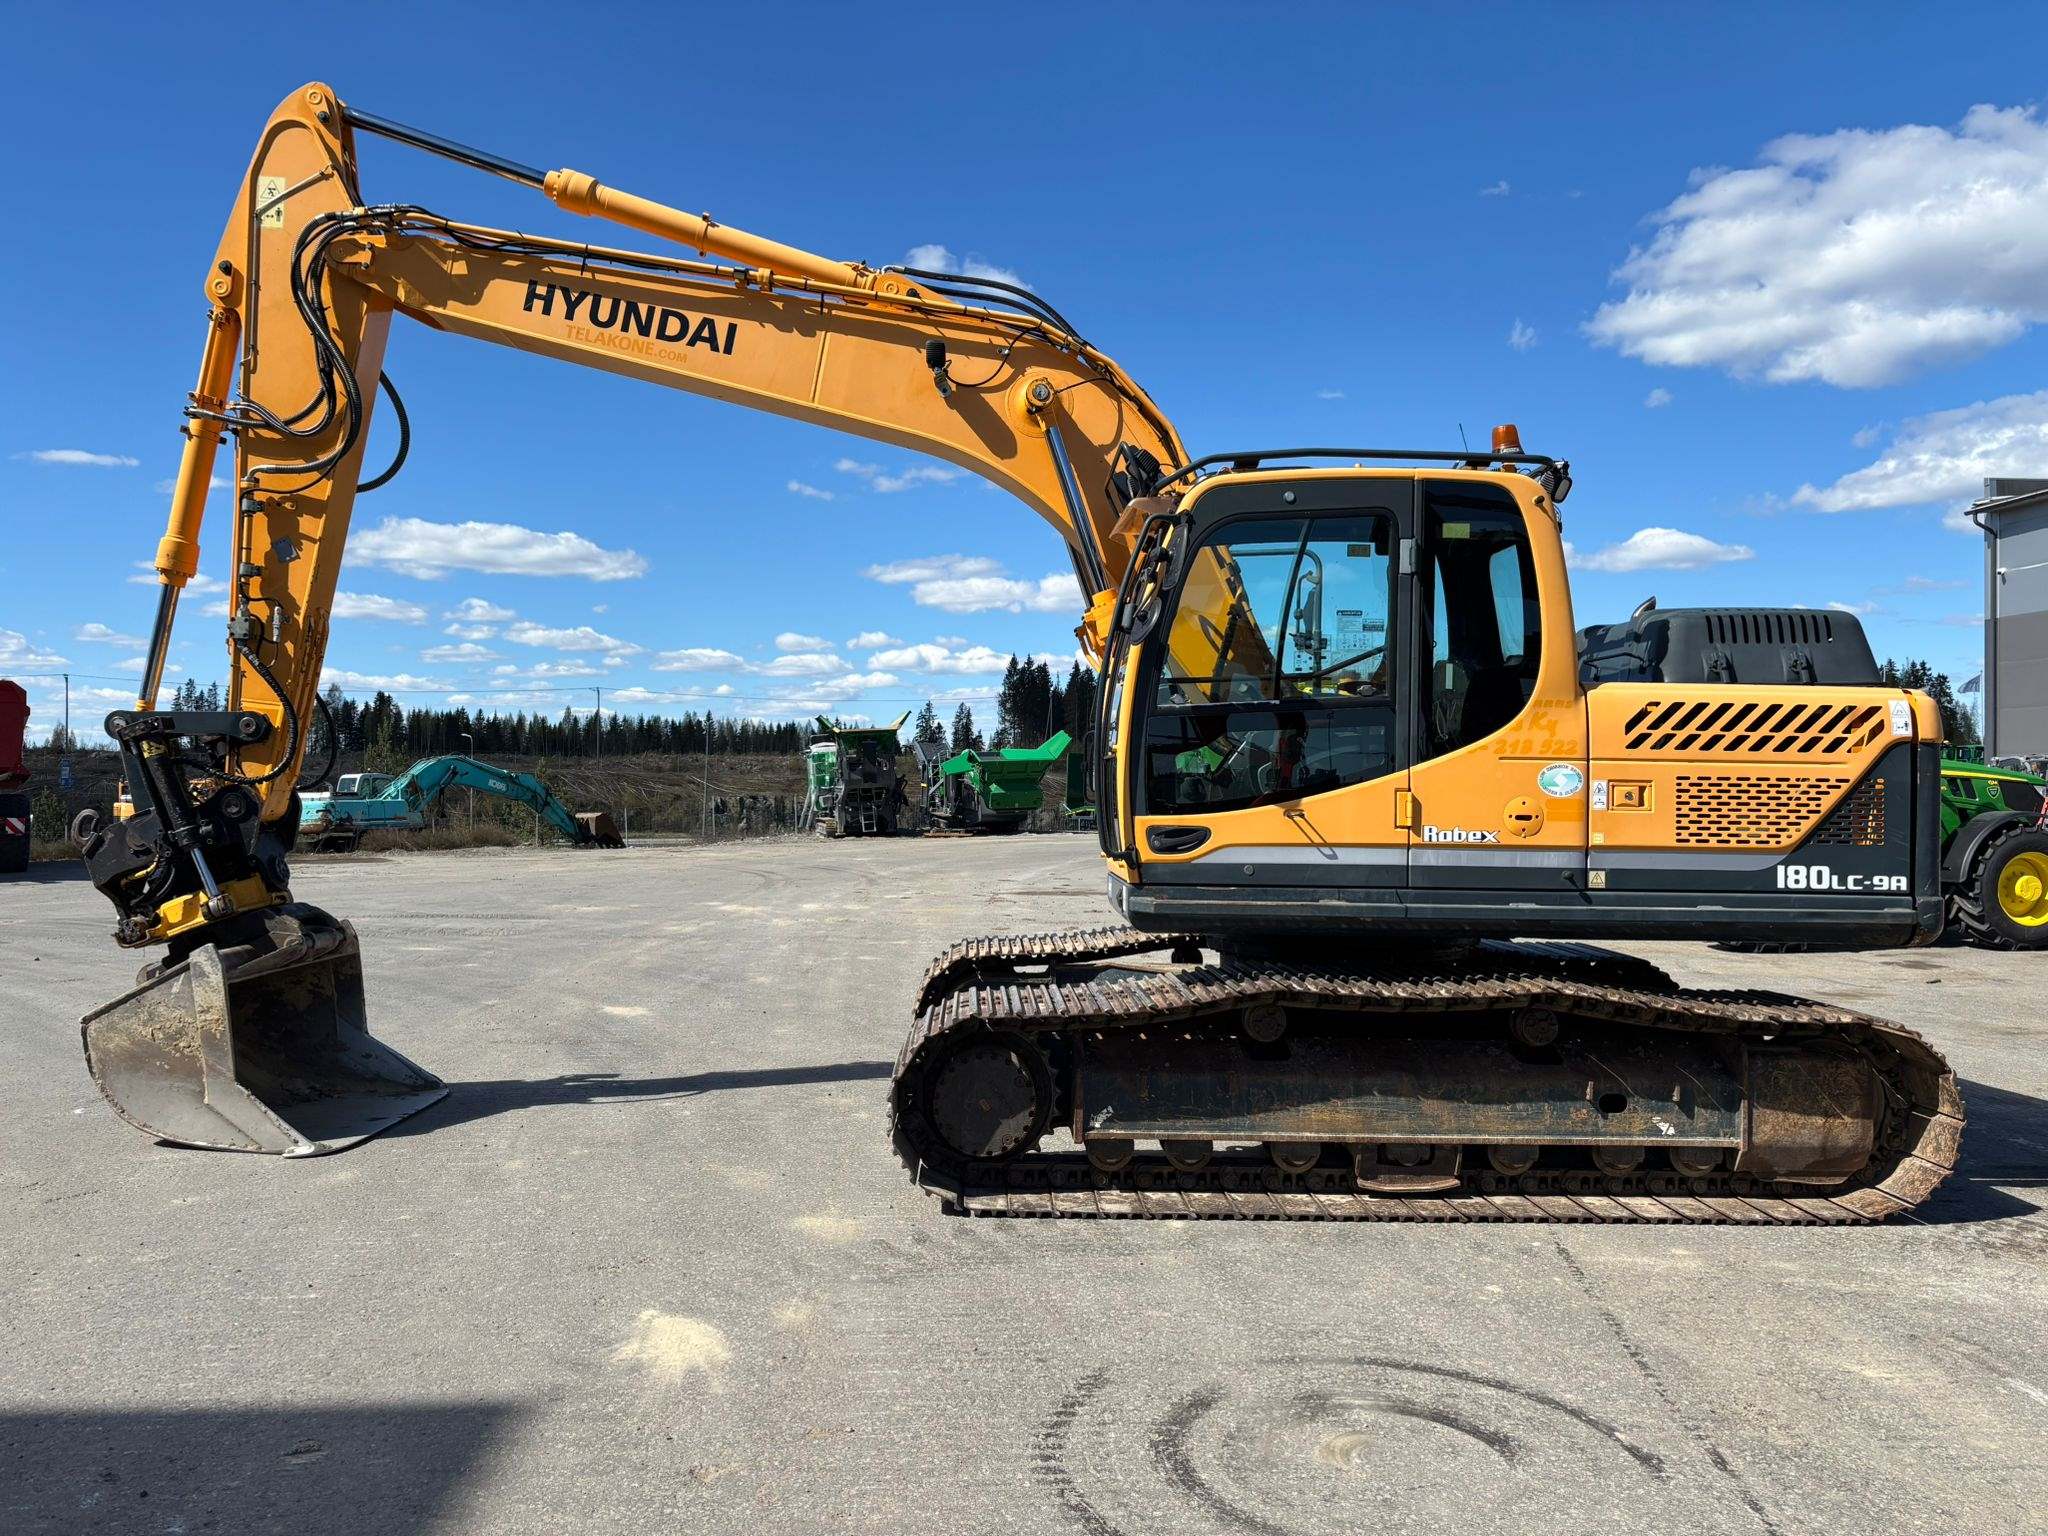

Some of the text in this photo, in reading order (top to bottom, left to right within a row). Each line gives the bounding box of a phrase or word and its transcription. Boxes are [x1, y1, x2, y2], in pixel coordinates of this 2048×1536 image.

[523, 279, 738, 356] HYUNDAI
[1422, 825, 1501, 843] Robex
[1776, 865, 1907, 891] 180LC-9A
